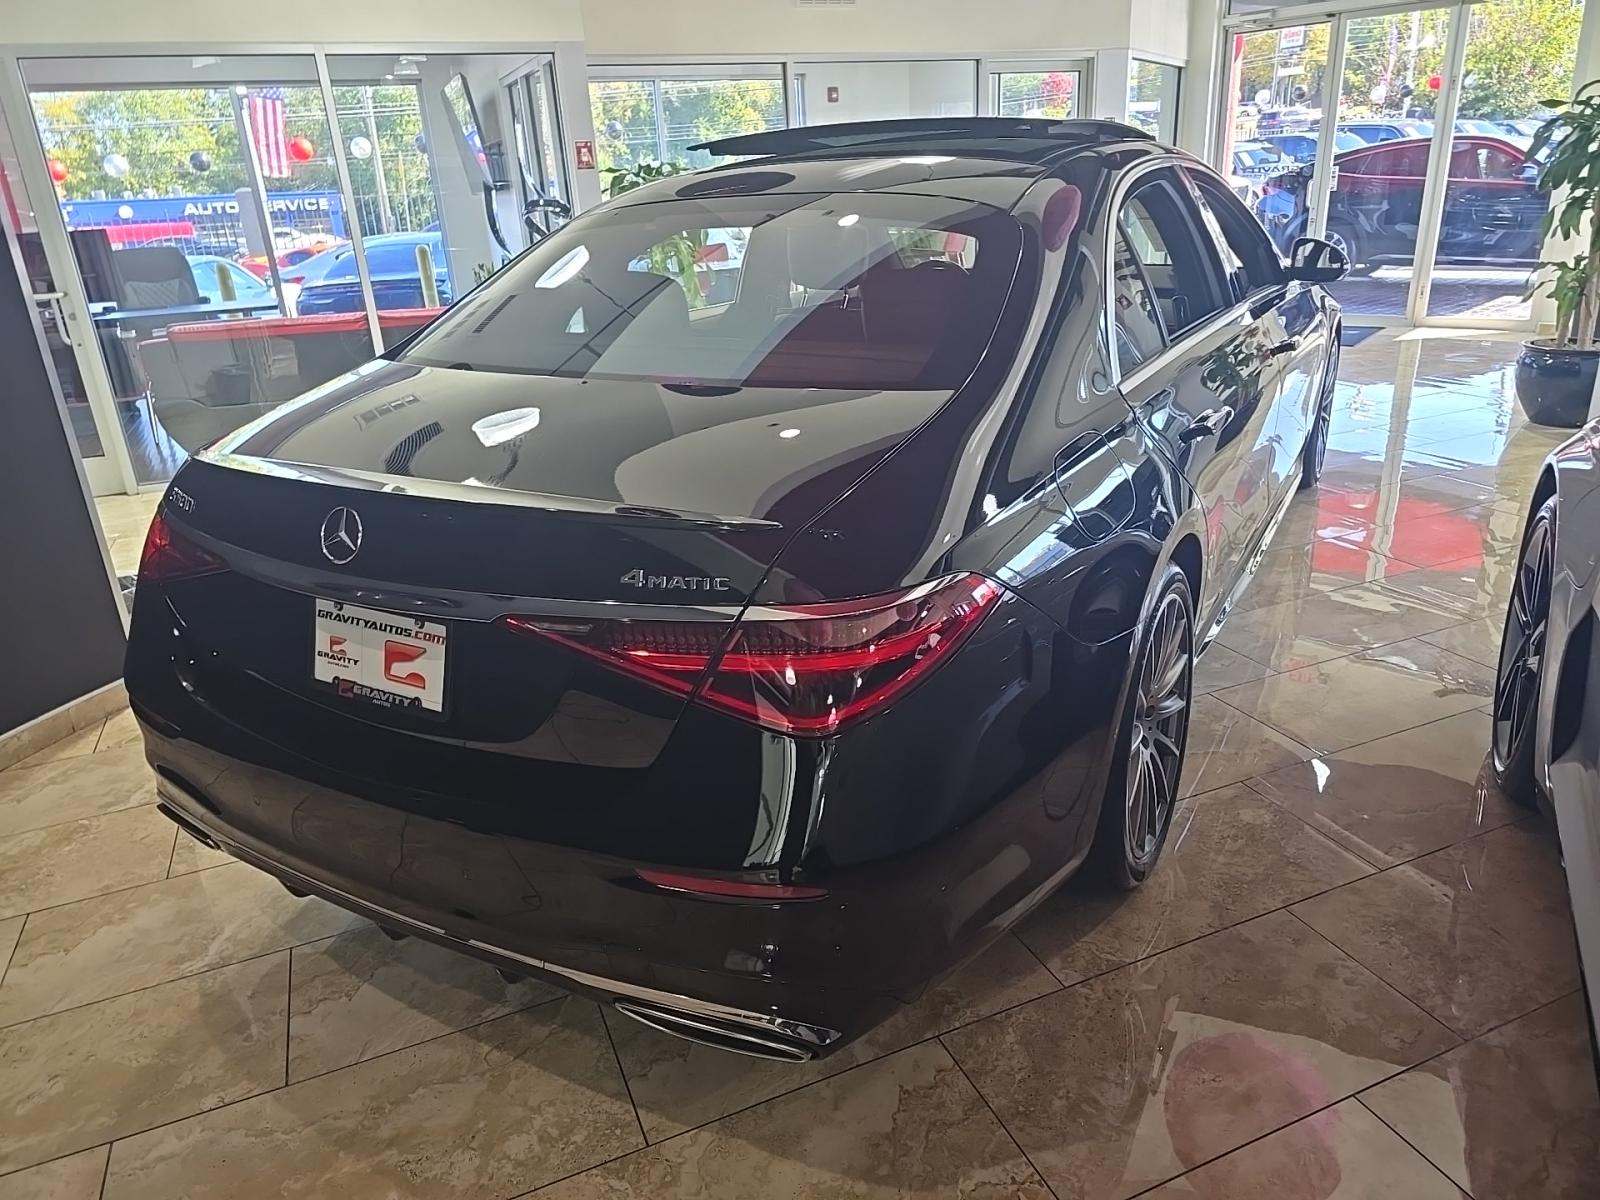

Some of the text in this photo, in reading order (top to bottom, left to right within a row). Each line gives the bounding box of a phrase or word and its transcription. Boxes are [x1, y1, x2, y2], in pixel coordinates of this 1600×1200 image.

[184, 197, 329, 215] AUTO ERVICE
[620, 569, 731, 591] 4MATIC
[317, 650, 360, 666] GRAVITY
[353, 685, 412, 707] GRAVITY
